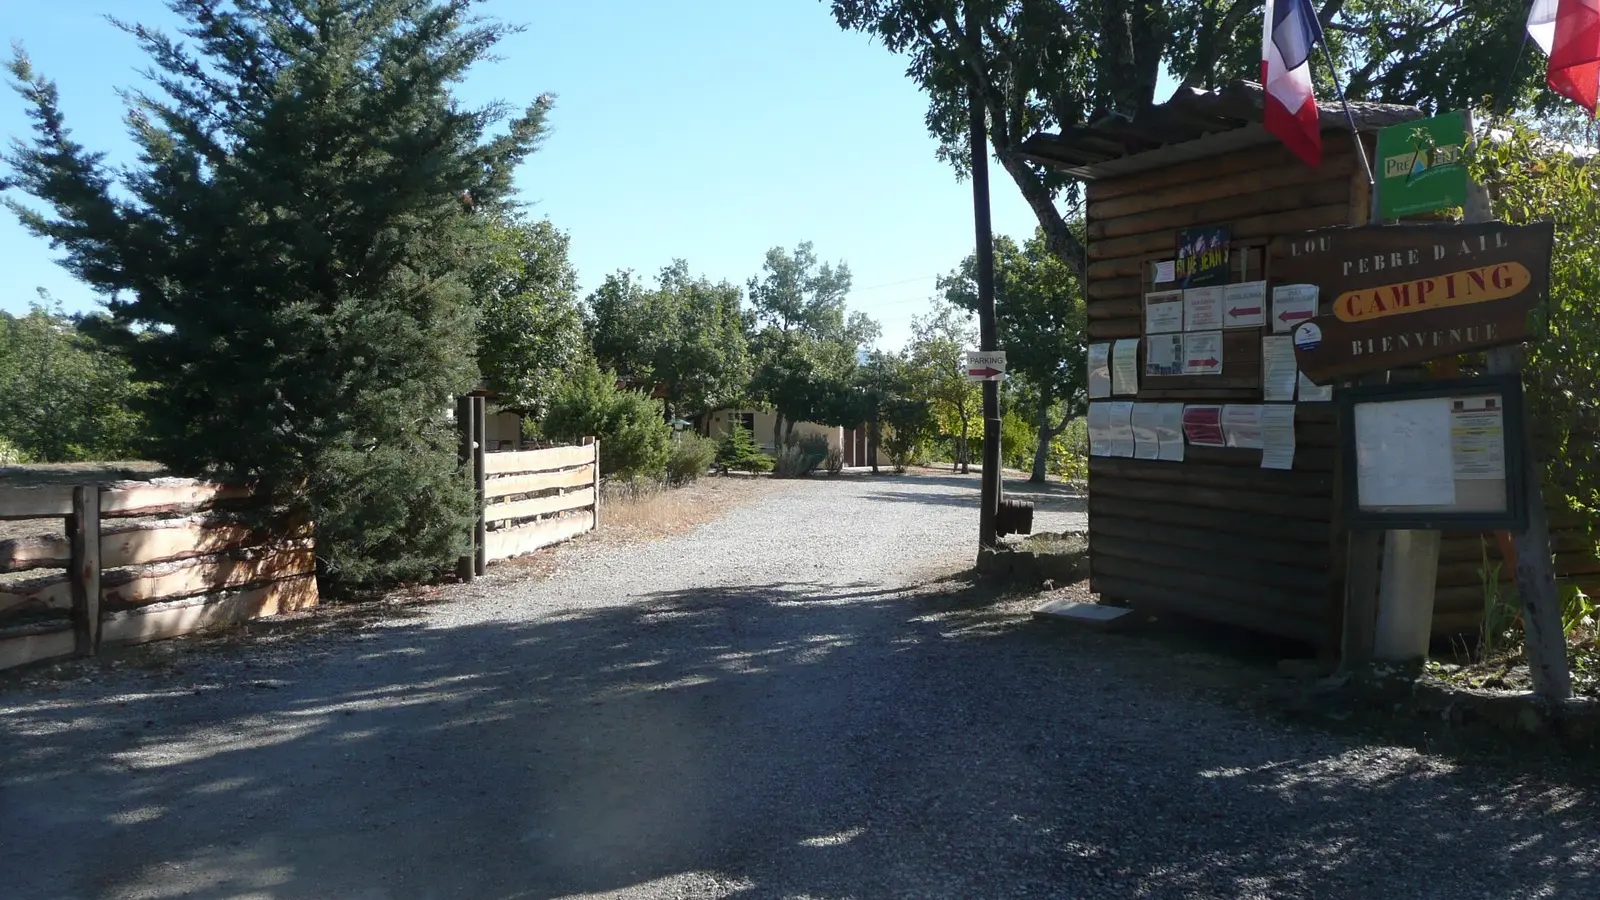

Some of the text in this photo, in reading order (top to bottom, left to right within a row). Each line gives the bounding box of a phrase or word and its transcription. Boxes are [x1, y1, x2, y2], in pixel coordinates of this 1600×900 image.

[1291, 236, 1331, 257] LOU
[1343, 232, 1508, 276] PEBRE D AIL
[1346, 265, 1513, 318] CAMPING
[1351, 322, 1498, 356] BIENVENUE
[969, 356, 1004, 365] PARKING
